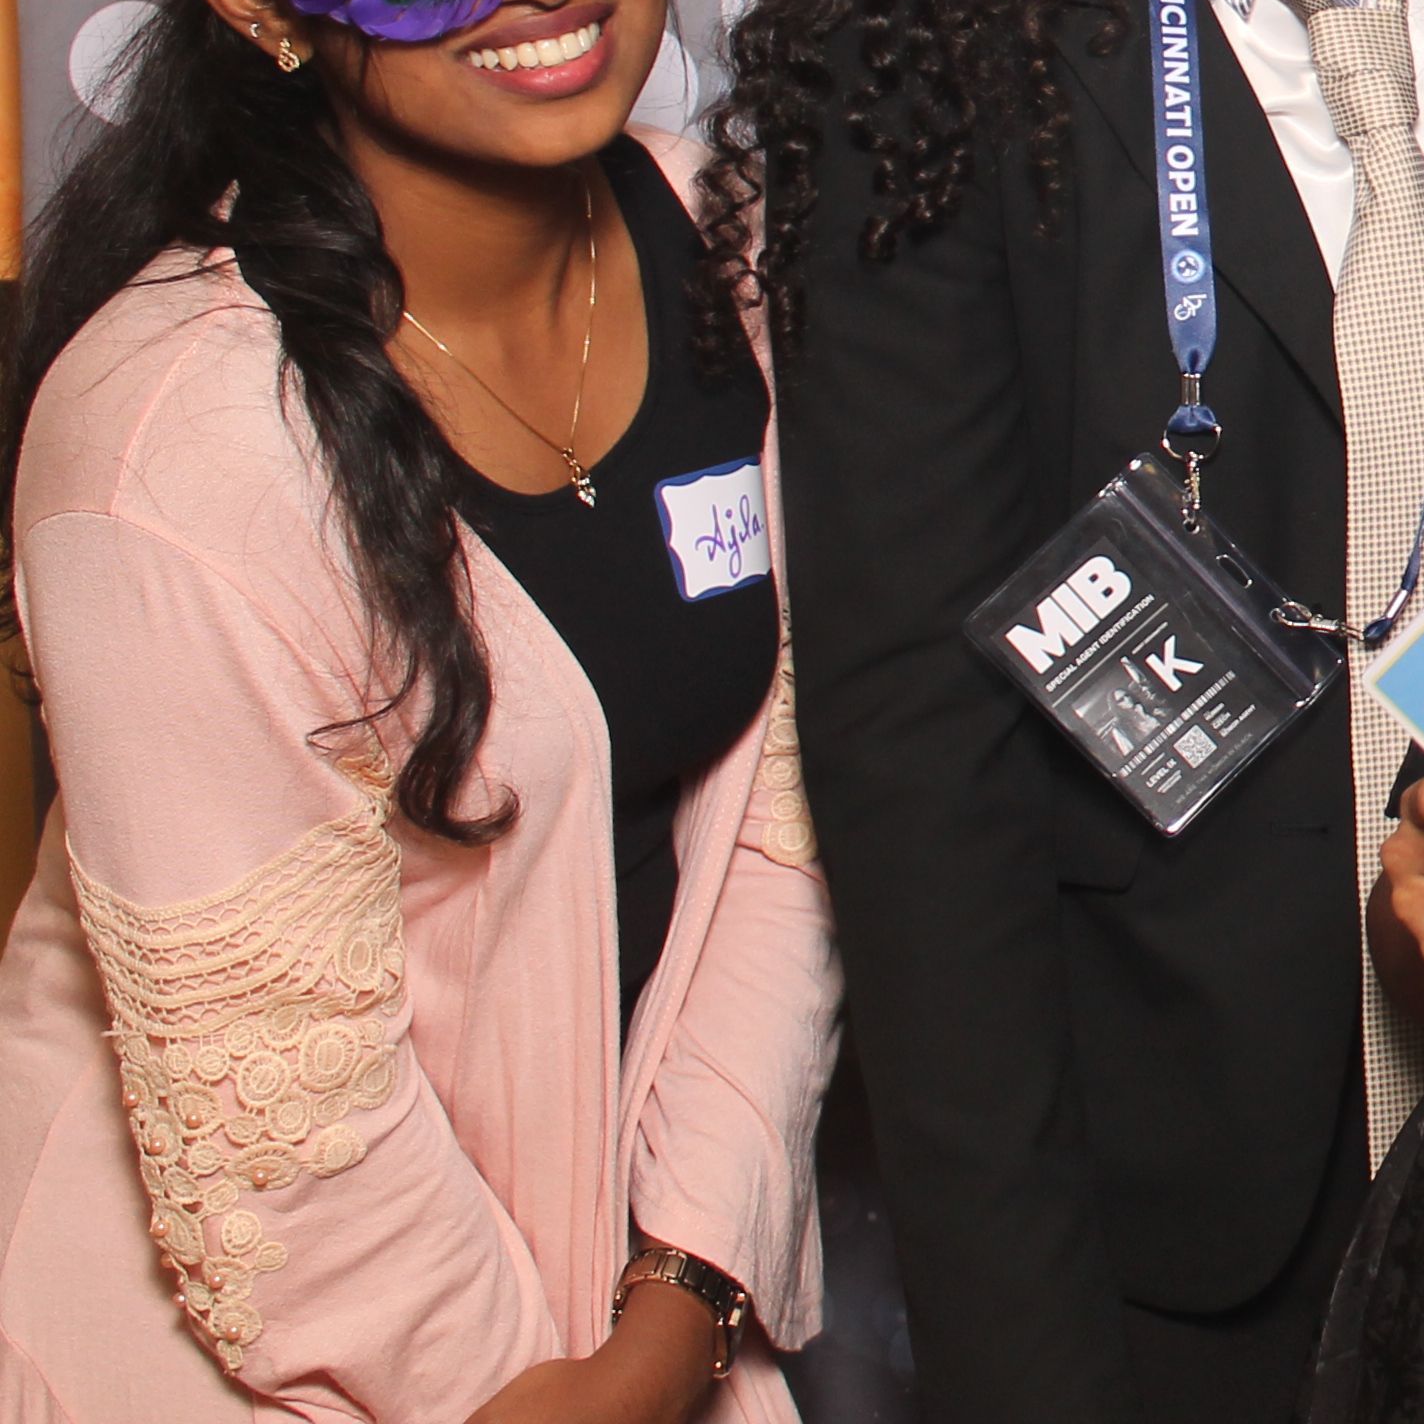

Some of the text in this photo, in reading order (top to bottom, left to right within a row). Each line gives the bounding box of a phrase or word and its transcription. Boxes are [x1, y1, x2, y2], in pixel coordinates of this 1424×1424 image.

[1164, 149, 1200, 237] OPEN
[1004, 555, 1132, 675] MIB
[1043, 661, 1079, 694] SPECIAL
[1073, 639, 1102, 667] AGENT
[1096, 591, 1155, 646] IDENTIFICATION
[1146, 634, 1205, 693] K
[1143, 763, 1170, 789] LEVEL
